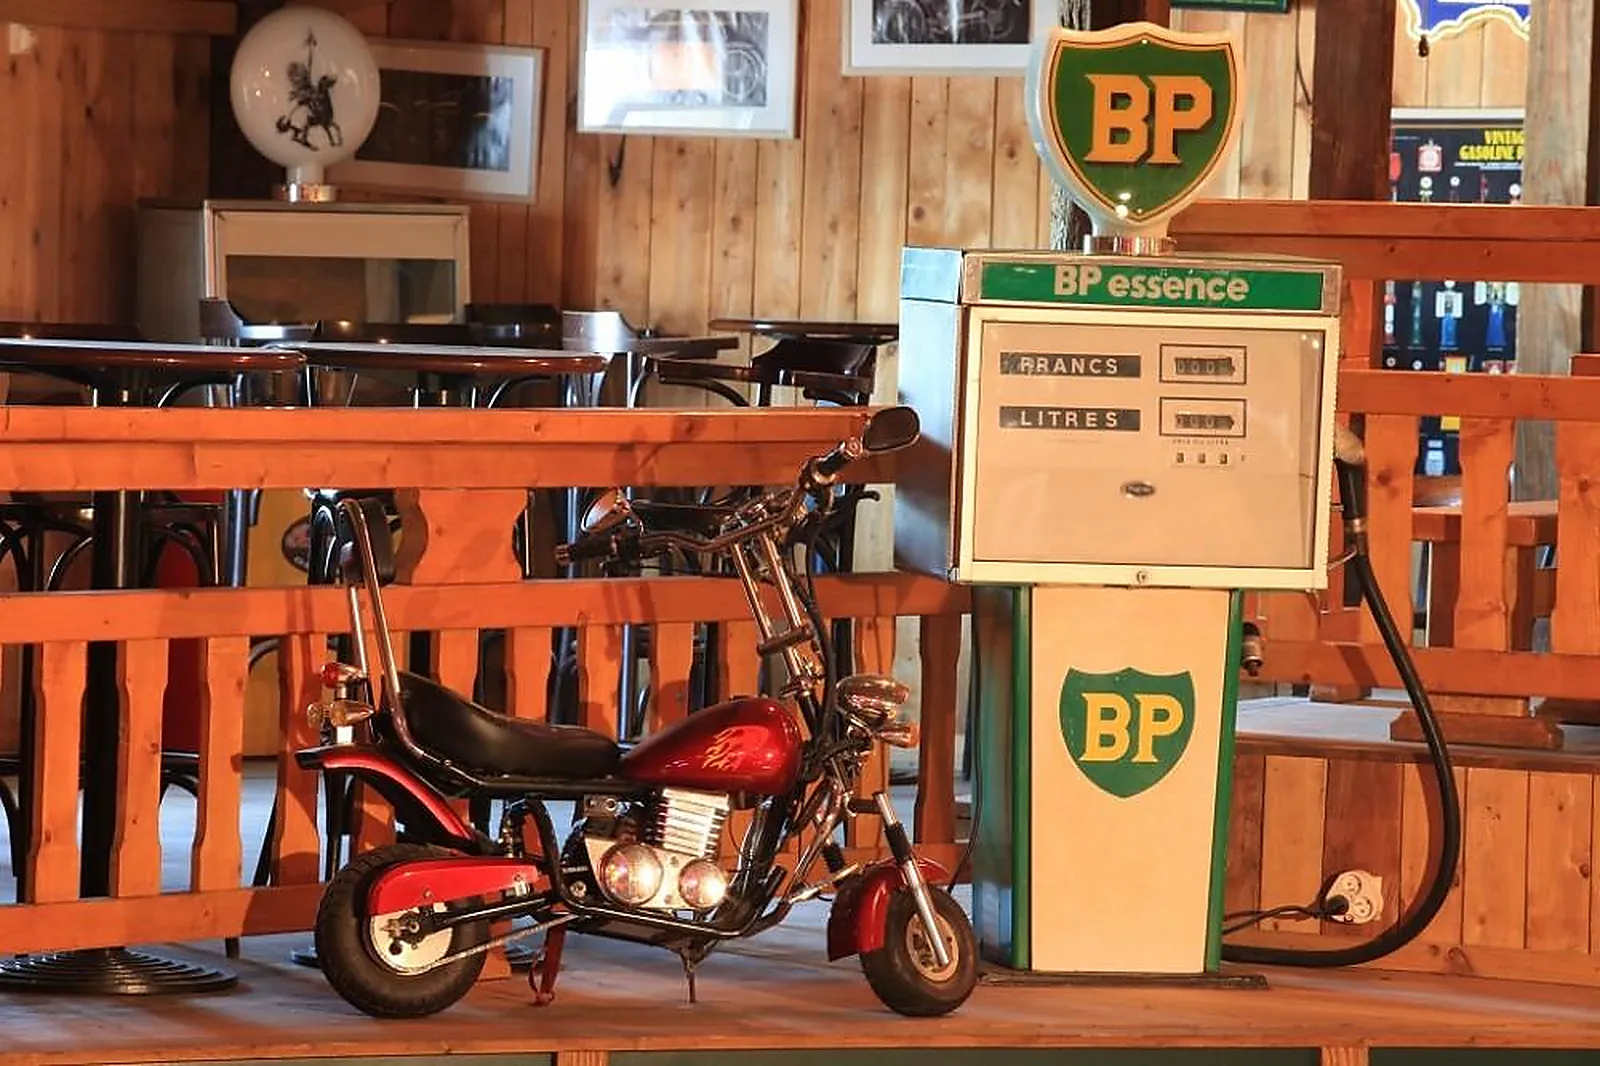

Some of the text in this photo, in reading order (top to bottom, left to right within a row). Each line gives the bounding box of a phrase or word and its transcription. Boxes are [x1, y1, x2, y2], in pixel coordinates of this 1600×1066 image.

[1084, 74, 1213, 164] BP
[1459, 145, 1517, 160] GASOLINE
[1054, 265, 1249, 301] BP essence
[1020, 410, 1118, 428] LITRES
[1079, 693, 1184, 763] BP
